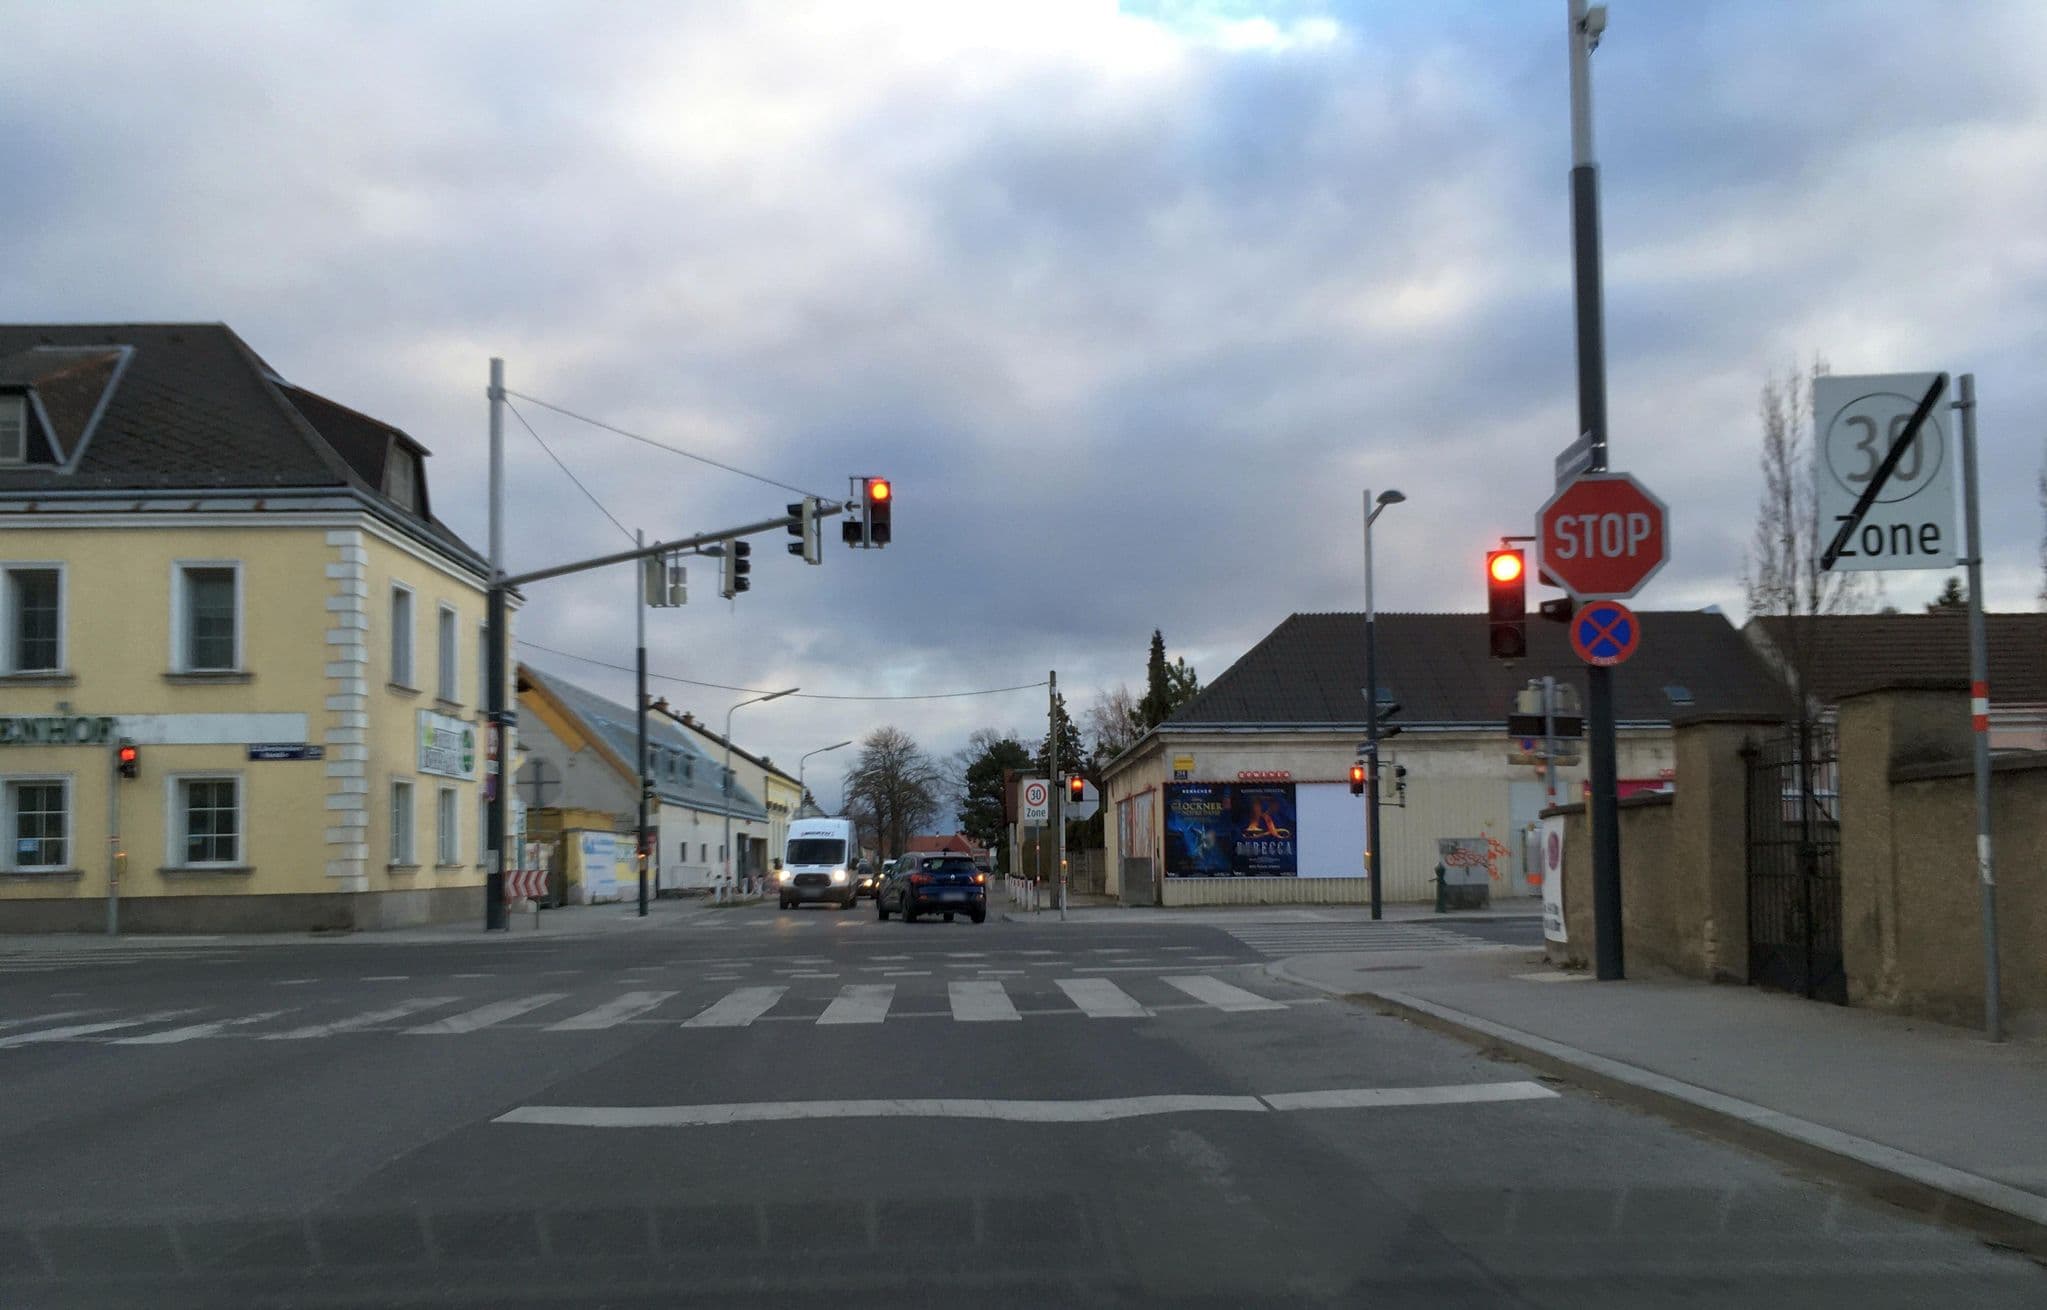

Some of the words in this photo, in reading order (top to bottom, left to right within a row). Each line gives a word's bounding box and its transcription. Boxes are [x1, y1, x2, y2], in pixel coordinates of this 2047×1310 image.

[1845, 413, 1924, 483] 30
[1554, 512, 1652, 560] STOP
[1833, 514, 1942, 558] Zone
[1026, 808, 1046, 818] Zone
[1031, 789, 1042, 800] 30
